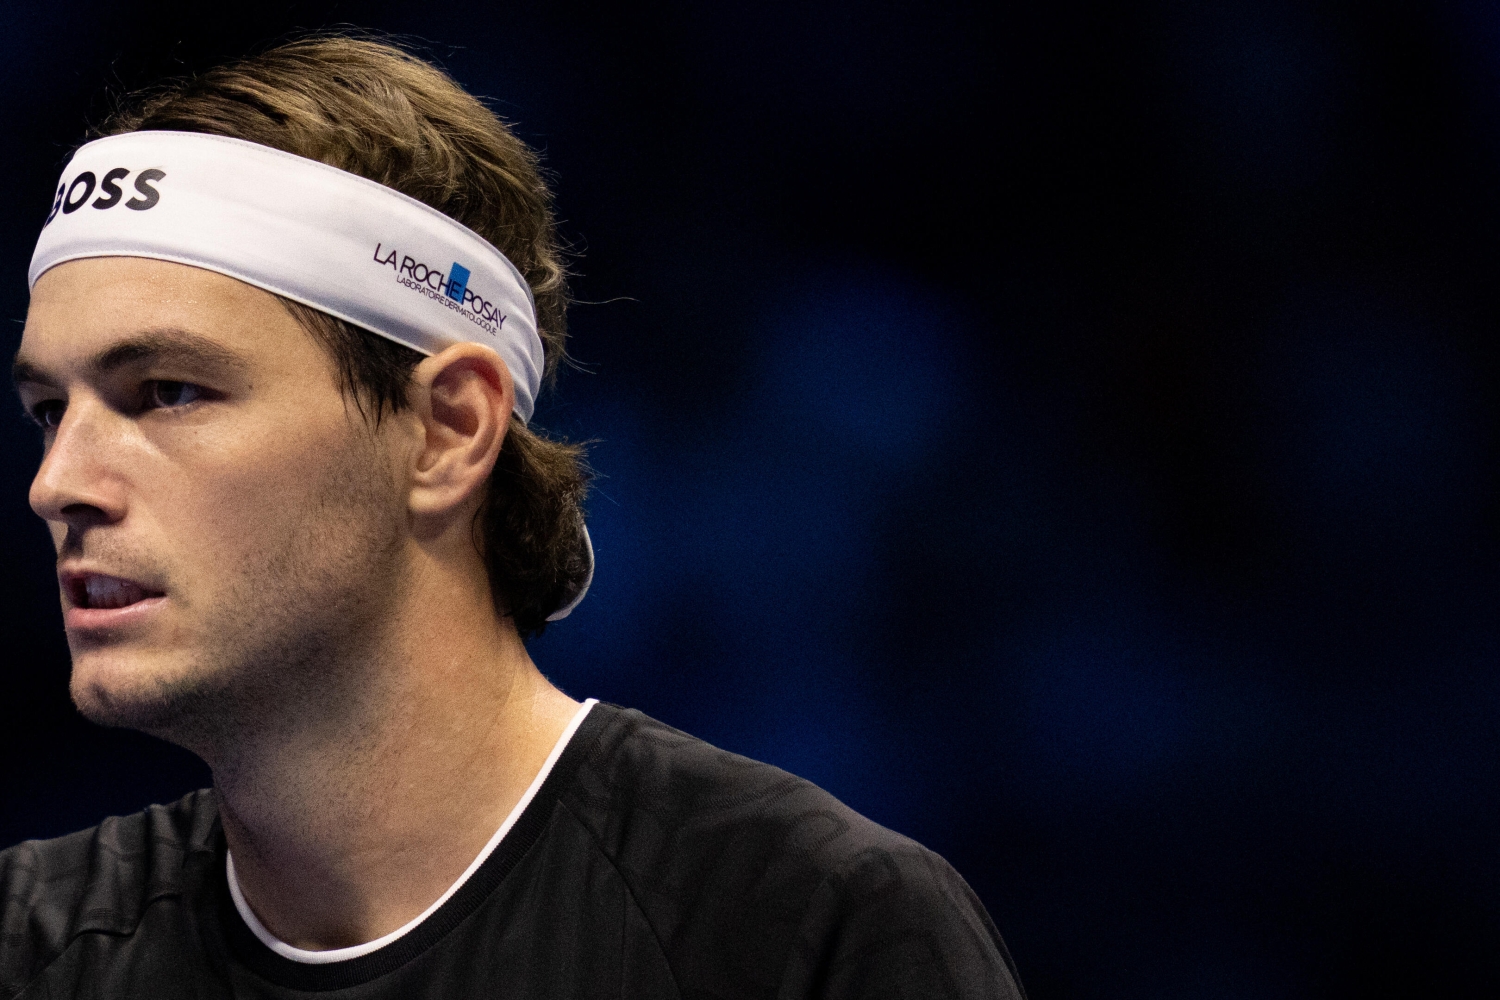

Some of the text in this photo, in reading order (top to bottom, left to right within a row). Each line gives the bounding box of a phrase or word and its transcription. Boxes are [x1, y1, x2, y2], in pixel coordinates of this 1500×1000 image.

[373, 243, 507, 330] LA ROCHE POSAY
[396, 275, 445, 305] LABORATOIRE
